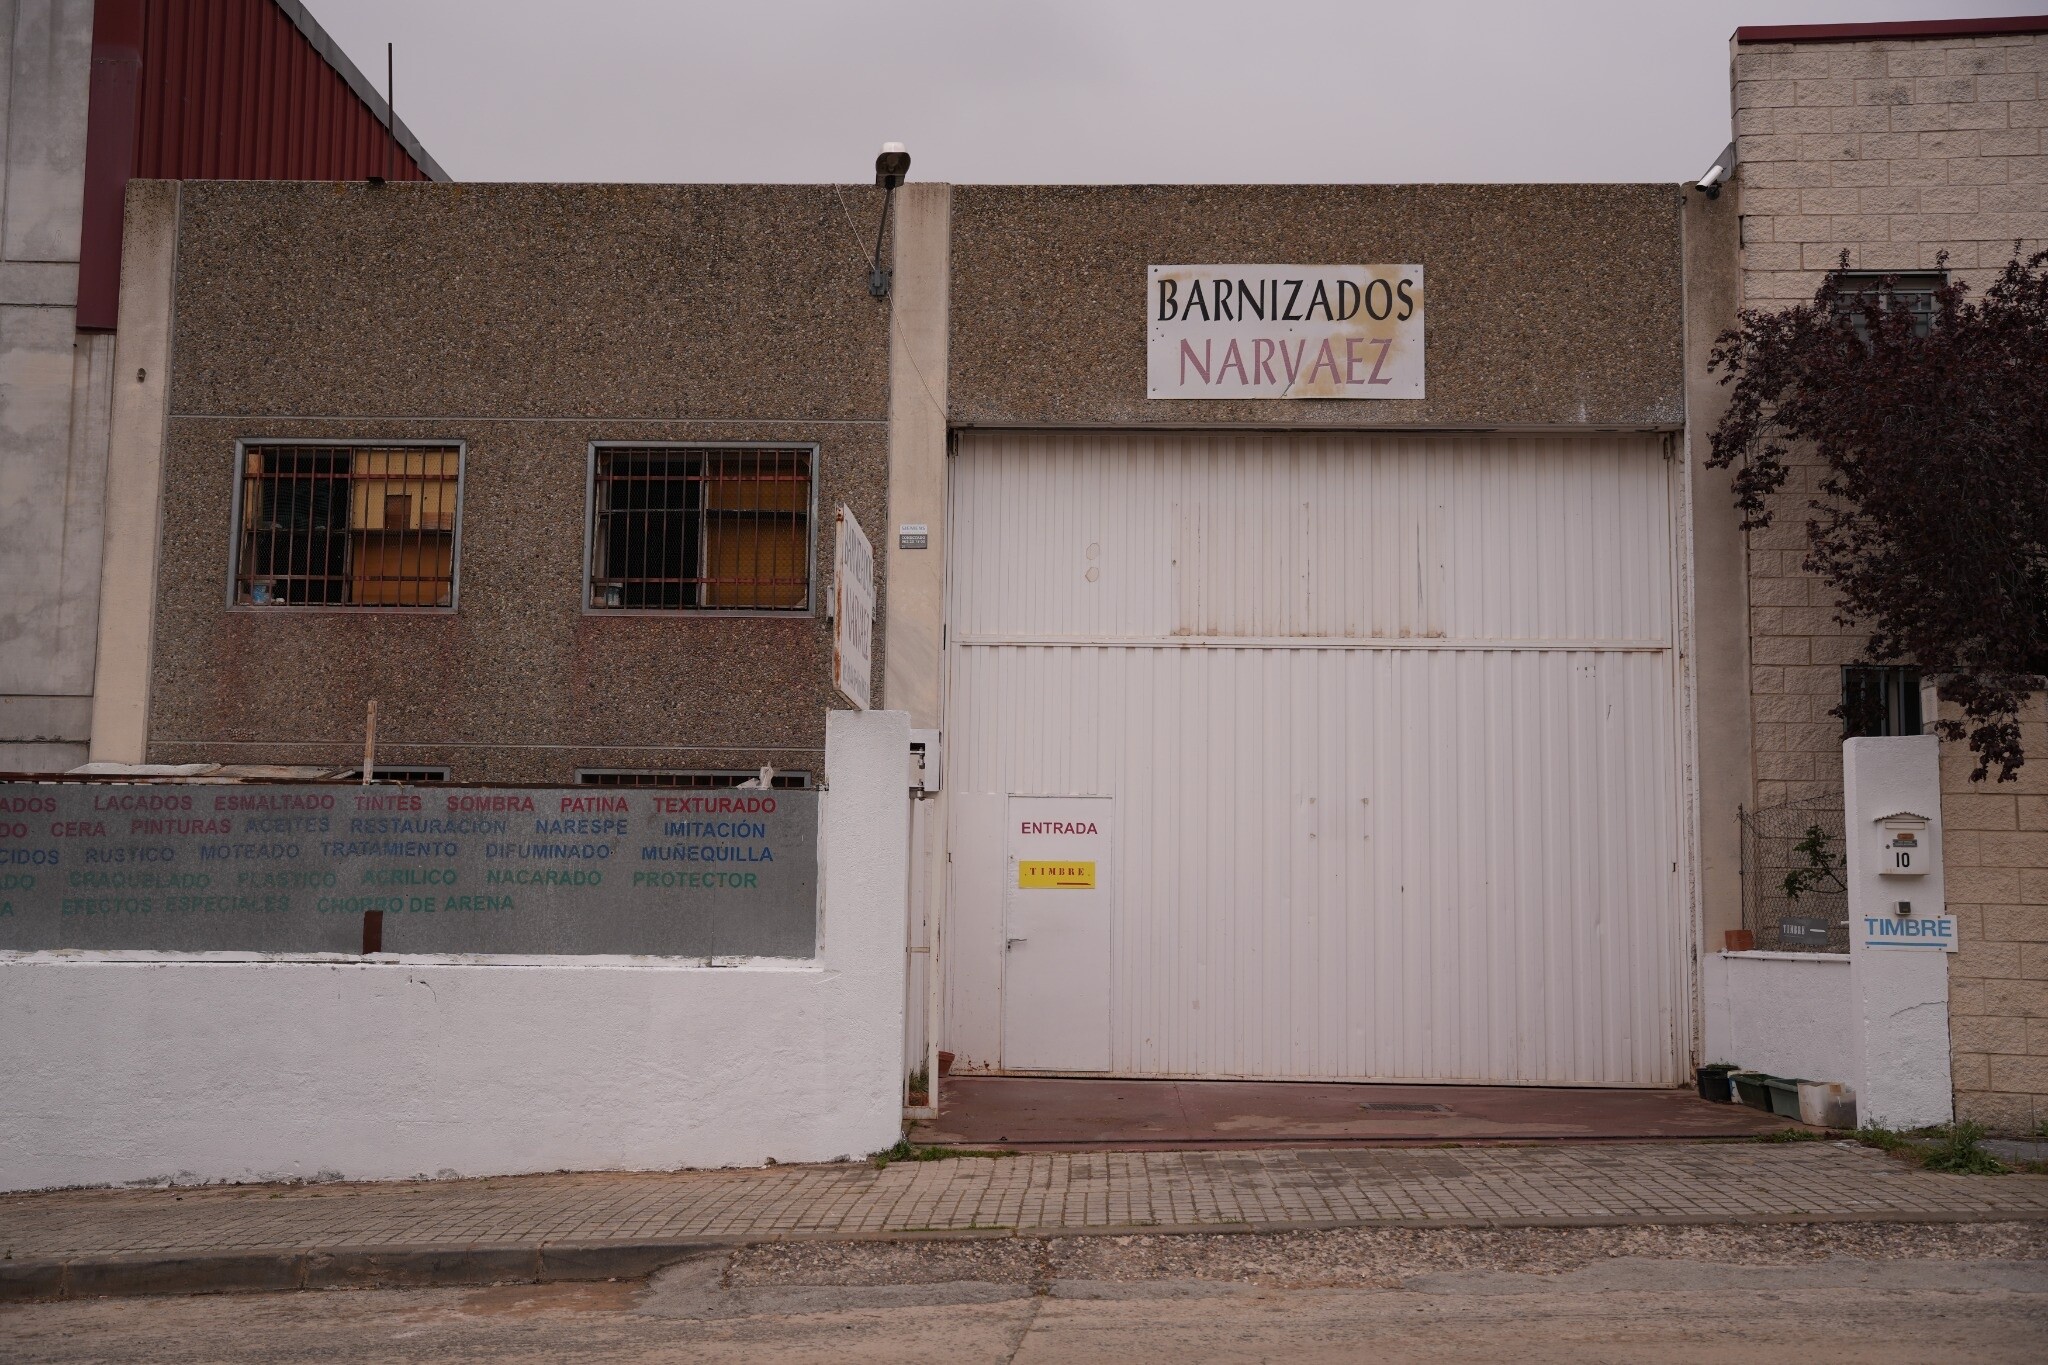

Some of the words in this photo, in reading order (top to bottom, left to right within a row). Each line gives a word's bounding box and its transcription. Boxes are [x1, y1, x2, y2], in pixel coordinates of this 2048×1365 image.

[1157, 278, 1414, 323] BARNIZADOS
[1179, 338, 1393, 386] NARVAEZ
[0, 797, 57, 813] ADOS
[94, 795, 192, 811] LACADOS
[214, 795, 335, 811] ESMALTADO
[353, 795, 423, 811] TINTES
[447, 795, 535, 812] SOMBRA
[560, 796, 629, 812] PATINA
[655, 797, 777, 813] TEXTURADO
[51, 821, 107, 838] CERA
[131, 819, 231, 835] PINTURAS
[245, 816, 330, 834] ACEITES
[535, 818, 628, 835] NARESPE
[664, 818, 765, 838] IMITACIÓN
[1021, 822, 1098, 834] ENTRADA
[85, 847, 175, 864] RUSTICO
[201, 843, 299, 861] MOTEADO
[321, 841, 458, 858] TRATAMIENTO
[485, 843, 610, 860] DIFUMINADO
[641, 842, 774, 863] MUÑEQUILLA
[1896, 852, 1910, 868] 10
[0, 873, 36, 890] DO
[69, 871, 211, 890] CRAQUELADO
[236, 871, 337, 889] PLASTICO
[361, 868, 459, 886] ACRILICO
[486, 868, 602, 886] NACARADO
[633, 871, 757, 889] PROTECTOR
[62, 898, 152, 916] EFECTOS
[165, 895, 290, 914] ESPECIALES
[317, 895, 404, 914] CHORRO
[409, 897, 436, 912] DE
[444, 895, 514, 911] ARENA
[1783, 924, 1806, 935] TIMBRE
[1864, 918, 1952, 937] TIMBRE
